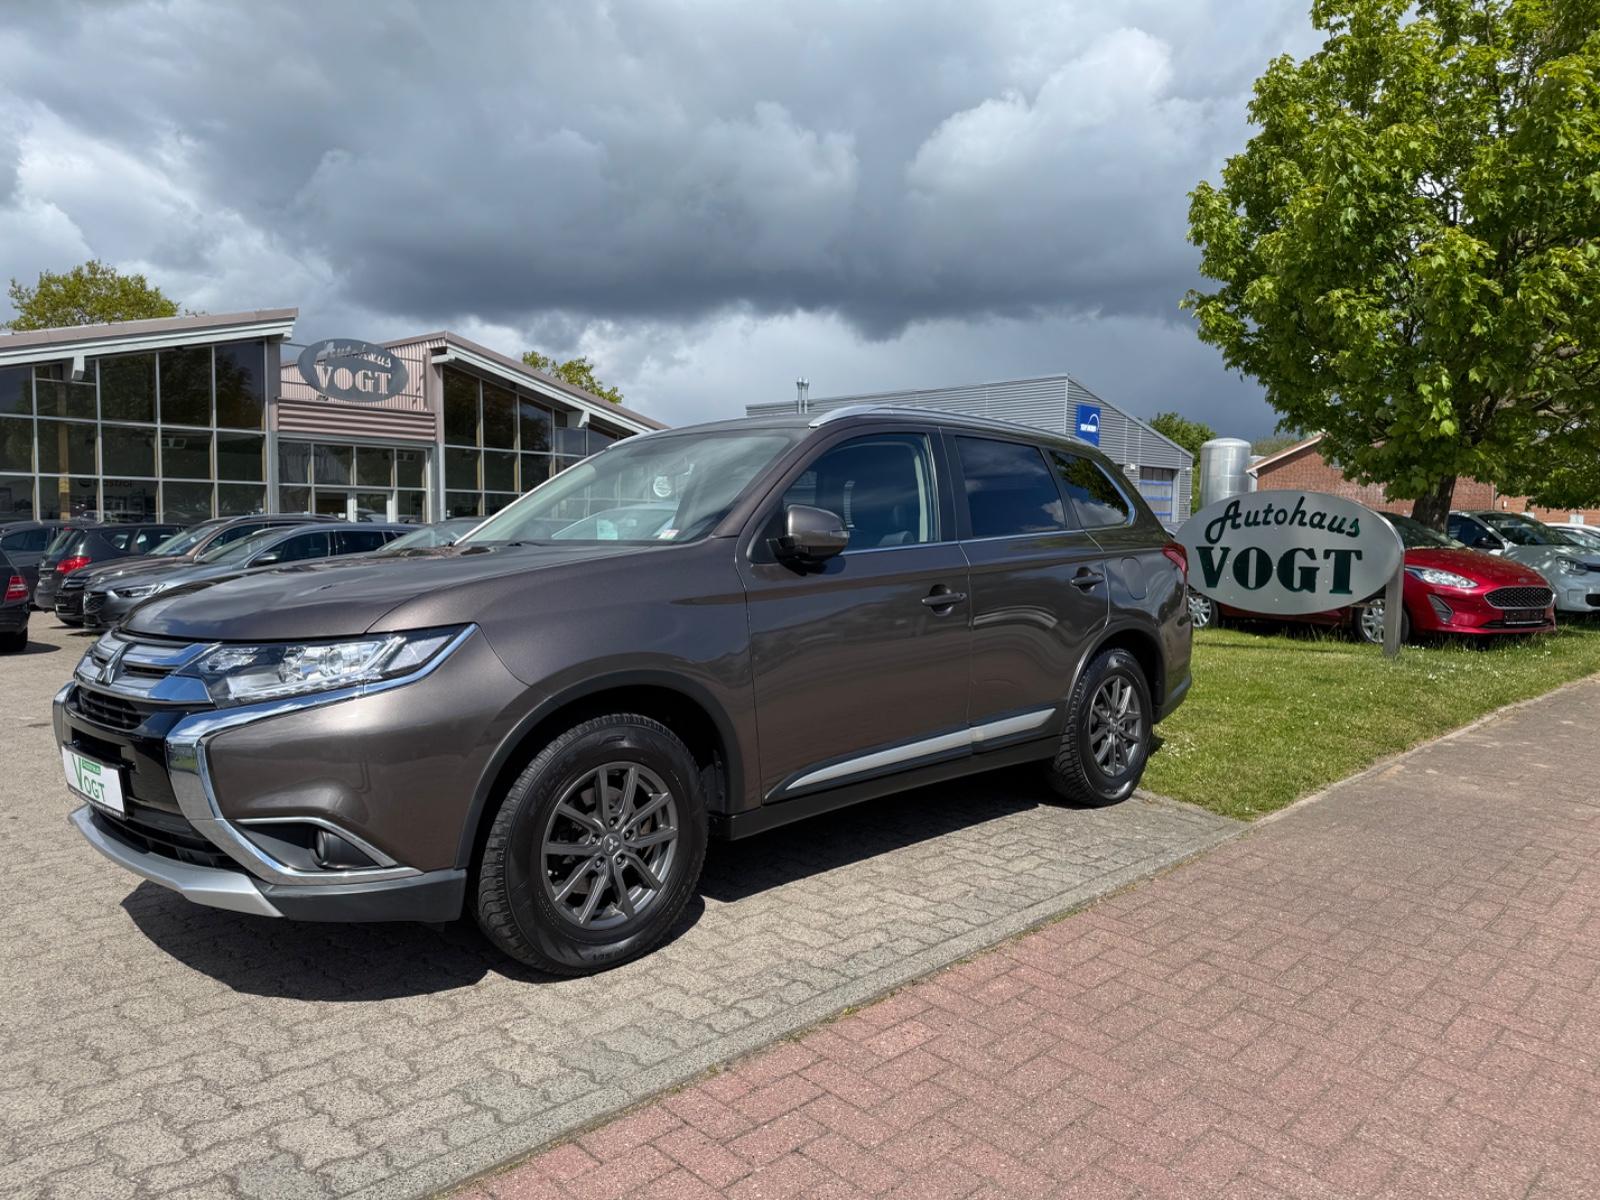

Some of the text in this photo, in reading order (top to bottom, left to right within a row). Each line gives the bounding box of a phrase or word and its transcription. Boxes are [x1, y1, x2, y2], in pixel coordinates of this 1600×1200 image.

[313, 364, 391, 394] VOGT
[1204, 496, 1360, 544] Autohaus
[1196, 546, 1363, 595] VOGT
[71, 753, 106, 802] VOGT
